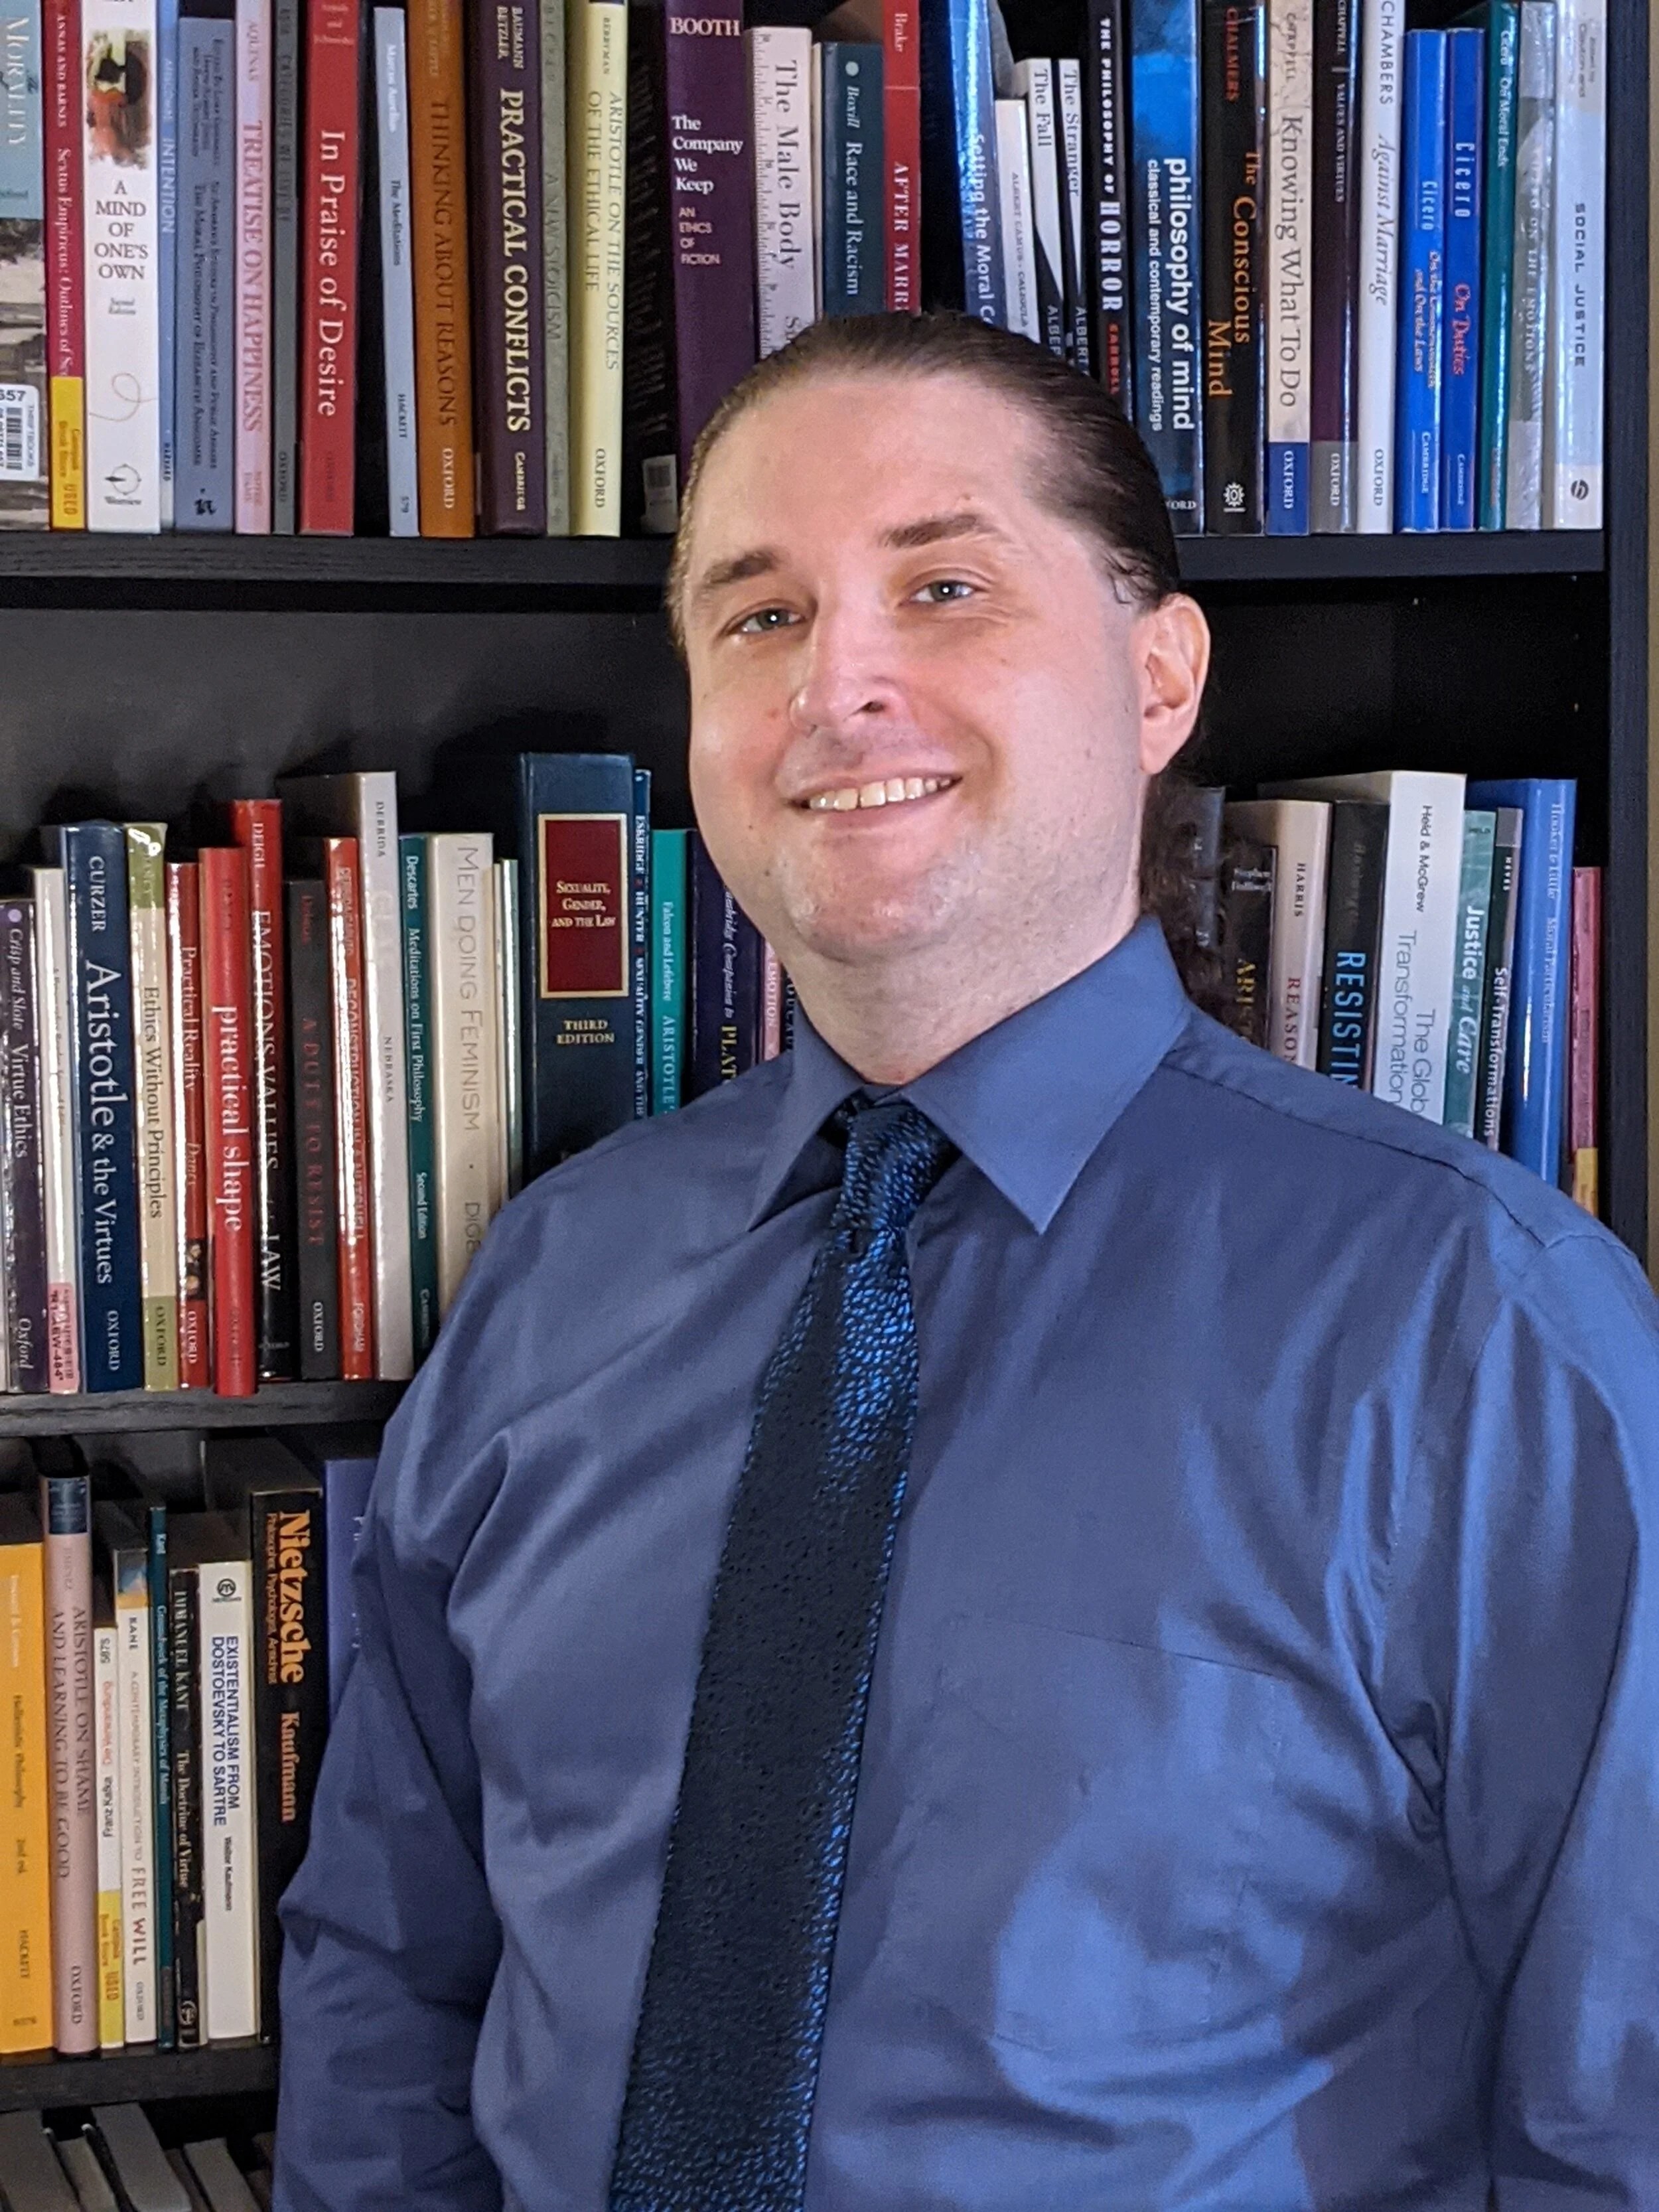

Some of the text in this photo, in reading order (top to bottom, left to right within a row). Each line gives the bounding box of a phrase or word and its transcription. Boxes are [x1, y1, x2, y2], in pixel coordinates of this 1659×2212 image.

[496, 5, 509, 60] BETZLER
[512, 6, 524, 69] BAUMANN
[601, 17, 612, 76] BERRYMAN
[668, 17, 741, 37] BOOTH
[894, 13, 909, 52] Brake
[1380, 0, 1395, 106] CHAMBERS
[671, 113, 702, 131] The
[672, 135, 744, 156] Company
[1034, 68, 1052, 147] The Fall
[1063, 68, 1082, 198] The Stranger
[114, 180, 129, 195] A
[161, 137, 175, 235] INTENTION
[430, 98, 454, 226] THINKING
[584, 90, 603, 292] OF THE ETHICAL LIFE
[674, 157, 698, 173] We
[675, 176, 715, 196] Keep
[773, 59, 803, 269] The Male Body
[844, 86, 864, 296] Boxill Race and Racism
[970, 134, 988, 202] Setting
[1100, 18, 1123, 311] THE PHILOSOPHY OF HORROR
[1455, 141, 1475, 218] Cicero
[95, 201, 147, 217] MIND
[108, 222, 135, 238] OF
[604, 92, 624, 371] ARISTOTLE ON THE SOURCES
[894, 161, 910, 311] AFTER MARRI
[975, 208, 991, 239] the
[1369, 134, 1396, 306] Against Marriage
[1420, 181, 1439, 230] Cicero
[94, 242, 149, 260] ONE'S
[98, 263, 146, 279] OWN
[243, 120, 264, 433] TREATISE ON HAPPINESS
[318, 129, 348, 417] In Praise of Desire
[433, 234, 455, 313] ABOUT
[500, 88, 531, 433] PRACTICAL CONFLICTS
[977, 244, 995, 299] Moral
[1233, 152, 1259, 344] The Conscious
[1274, 115, 1305, 408] Knowing What To Do
[1574, 202, 1586, 368] SOCIAL JUSTICE
[1147, 159, 1165, 431] classical and contemporary readings
[1164, 158, 1195, 430] philosophy of mind
[1451, 283, 1471, 376] On Duties
[436, 321, 458, 427] REASONS
[1108, 323, 1120, 396] CARROLL
[1208, 320, 1232, 397] Mind
[398, 394, 408, 439] HACKETT
[441, 447, 456, 509] OXFORD
[595, 447, 607, 508] OXFORD
[1283, 450, 1294, 509] OXFORD
[1330, 453, 1340, 506] OXFORD
[1373, 448, 1384, 506] OXFORD
[1420, 431, 1431, 494] CAMBRIDGE
[88, 855, 107, 932] CURZER
[405, 855, 420, 909] Descartes
[1293, 862, 1307, 918] HARRIS
[8, 928, 25, 1030] Crisp and Slote
[457, 846, 483, 1130] MEN DOING FEMINISM
[723, 942, 738, 1005] Companion
[725, 1006, 735, 1019] to
[1455, 905, 1486, 1074] Justice and Care
[180, 946, 201, 1092] Practical Reality
[407, 928, 426, 1122] Meditations on First Philosophy
[721, 1025, 738, 1085] PLAT
[1330, 951, 1367, 1088] RESISTIN
[1390, 930, 1418, 1103] Transformation
[1484, 966, 1509, 1138] Self-Transformations
[11, 1044, 33, 1158] Virtue Ethics
[384, 1035, 395, 1103] NEBRASKA
[1410, 1009, 1436, 1115] The Glob
[86, 959, 129, 1284] Aristotle & the Virtues
[143, 986, 167, 1218] Ethics Without Principles
[212, 1004, 250, 1232] practical shape
[17, 1317, 34, 1369] Oxford
[107, 1309, 120, 1371] OXFORD
[155, 1305, 167, 1367] OXFORD
[312, 1301, 324, 1352] OXFORD
[128, 1617, 139, 1651] KANE
[278, 1509, 312, 1685] Nietzsche
[52, 1609, 71, 1880] AND LEARNING TO BE GOOD
[72, 1605, 90, 1818] ARISTOTLE ON SHAME
[212, 1636, 228, 1826] DOSTOEVSKY TO SARTRE
[226, 1635, 241, 1809] EXISTENTIALISM FROM
[281, 1712, 301, 1824] Kaufmann
[18, 1930, 31, 1979] HACKETT
[70, 1964, 82, 2025] OXFORD
